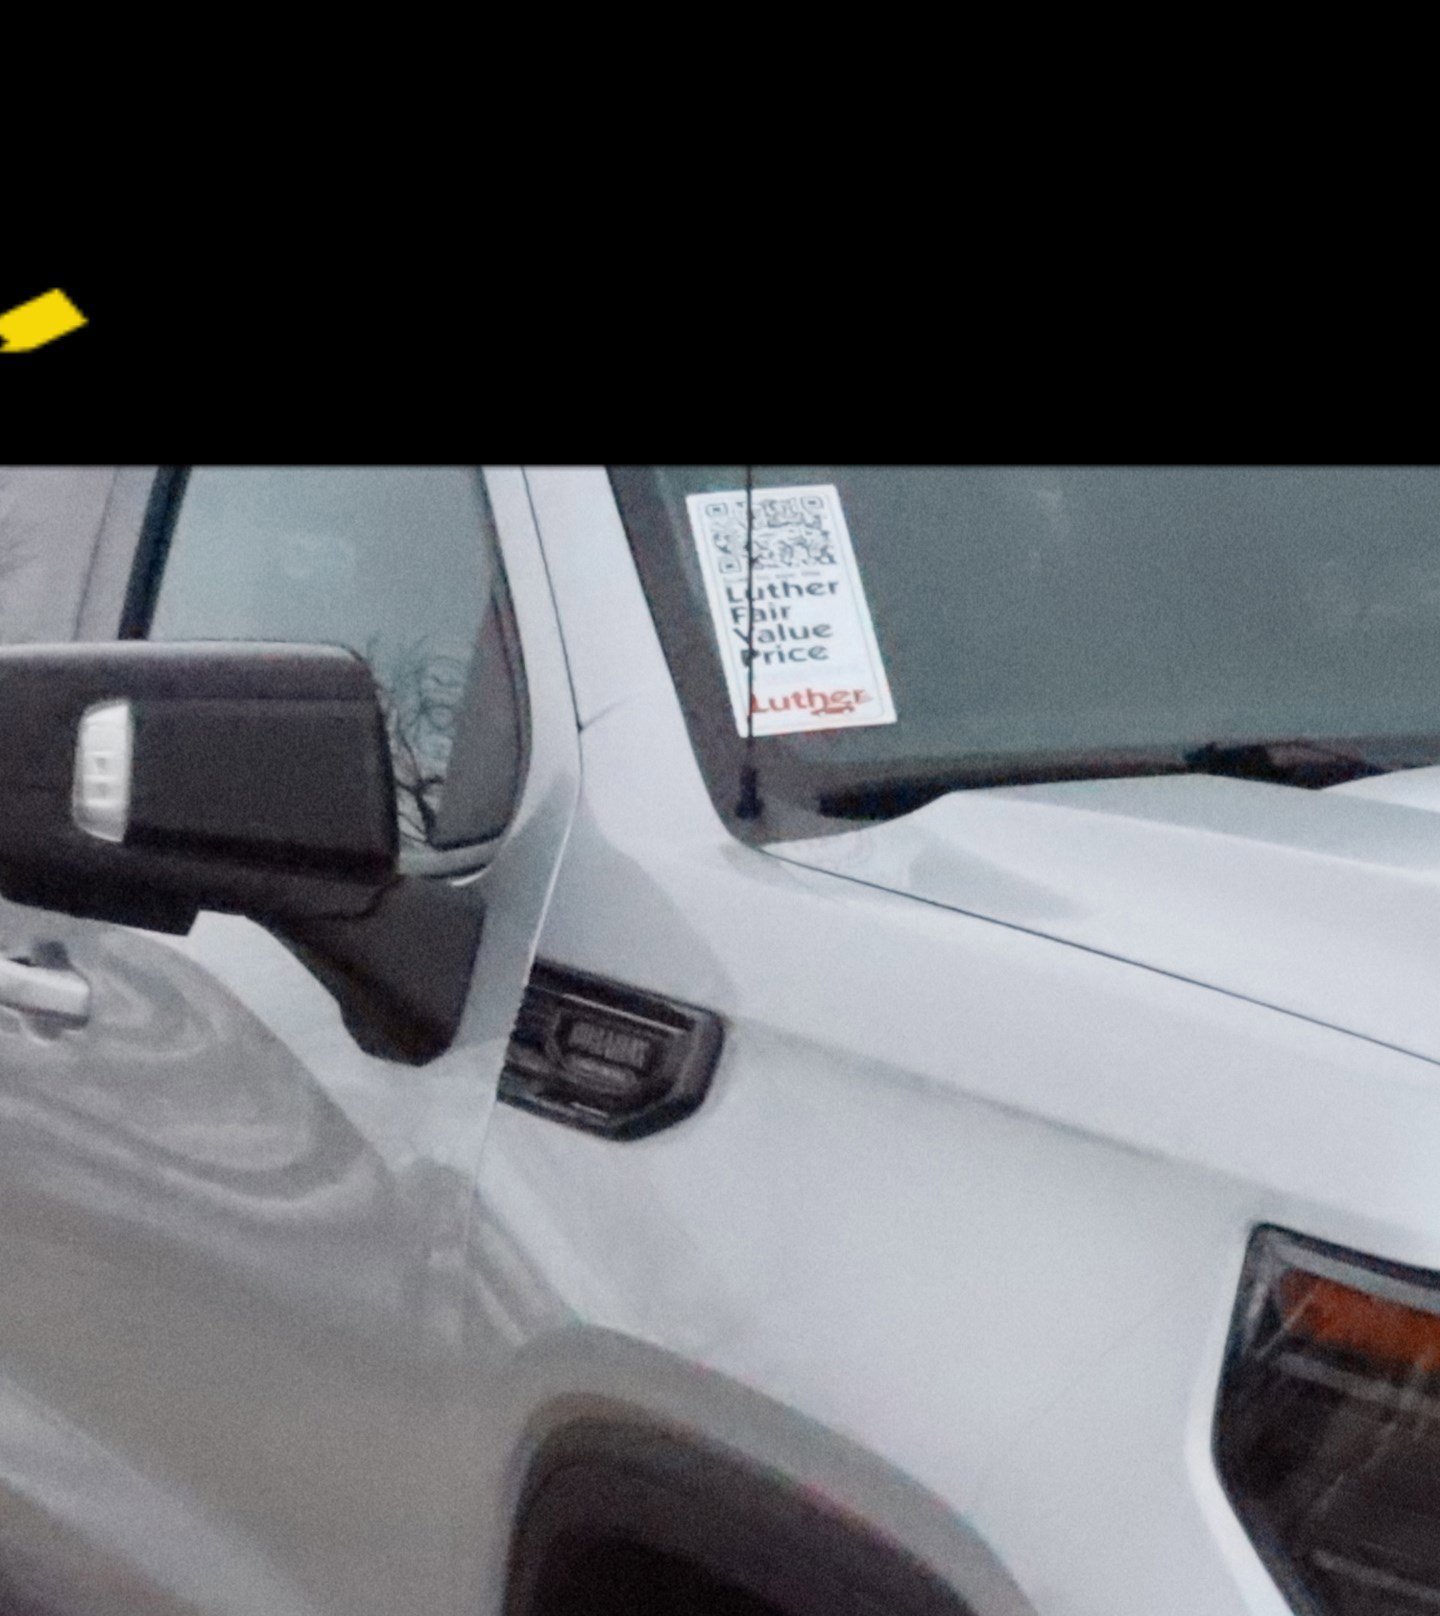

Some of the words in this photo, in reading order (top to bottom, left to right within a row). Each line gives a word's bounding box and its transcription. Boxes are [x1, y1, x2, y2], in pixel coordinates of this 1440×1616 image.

[725, 580, 840, 603] Luther
[730, 602, 792, 625] Fair
[732, 622, 834, 645] Value
[740, 644, 830, 668] Price
[751, 688, 867, 715] Luther
